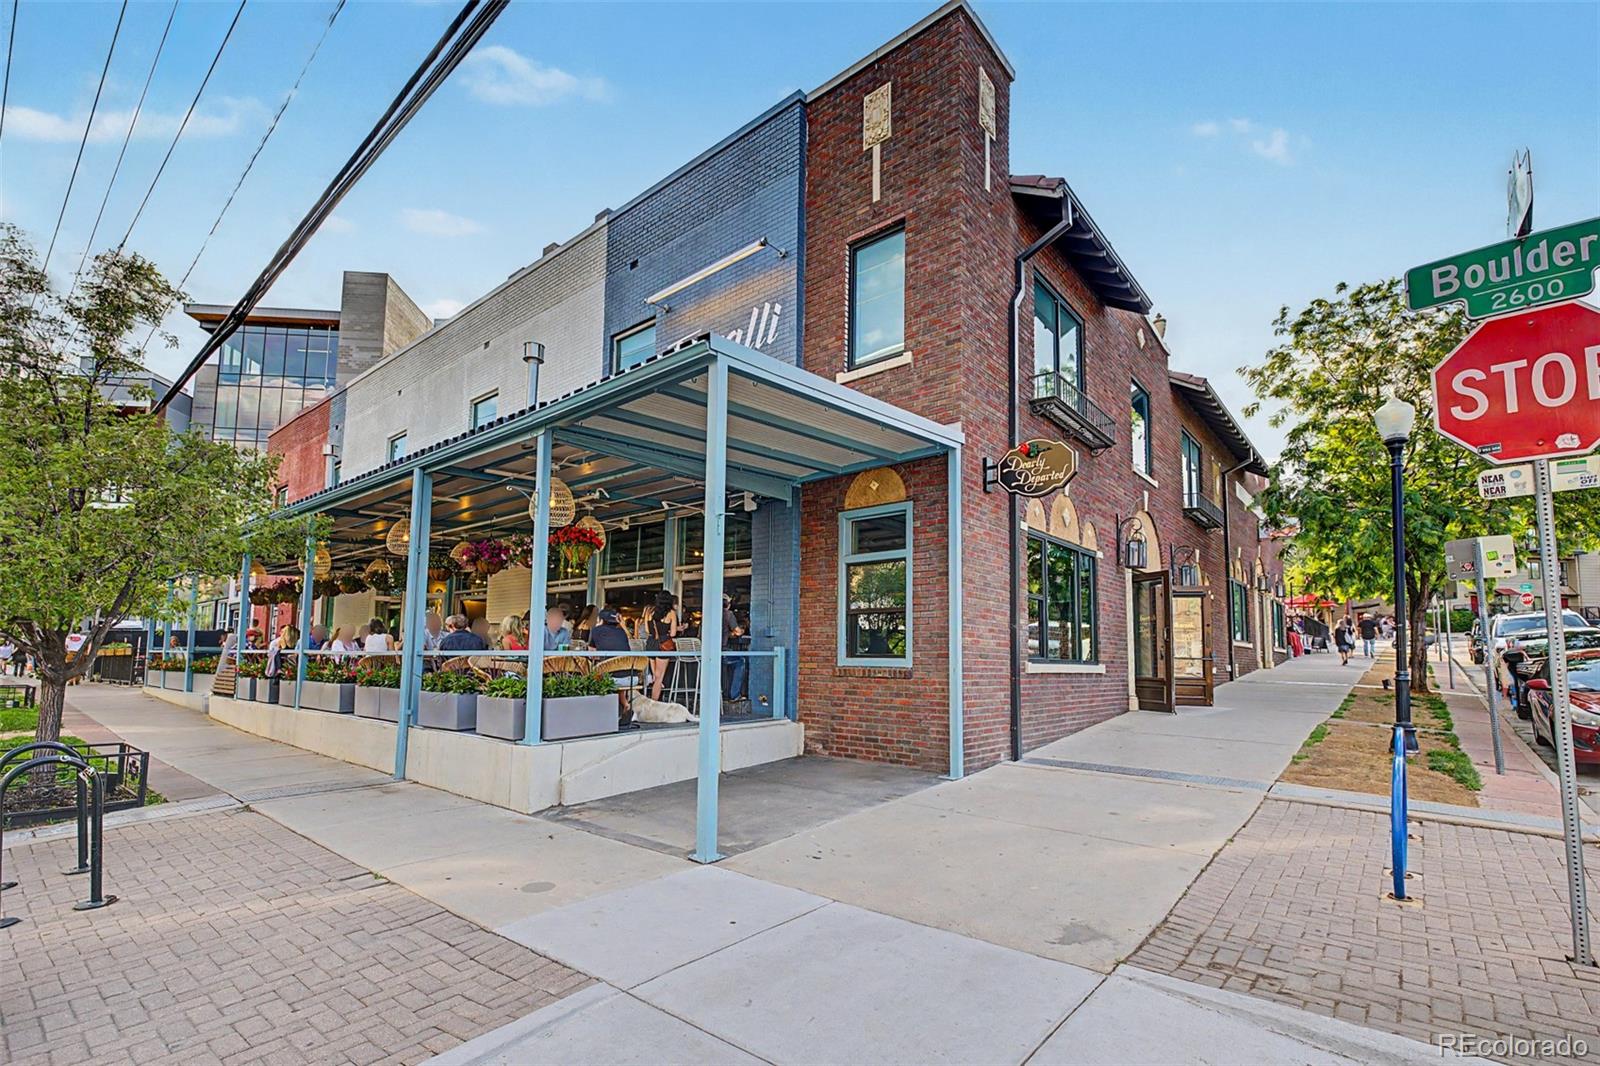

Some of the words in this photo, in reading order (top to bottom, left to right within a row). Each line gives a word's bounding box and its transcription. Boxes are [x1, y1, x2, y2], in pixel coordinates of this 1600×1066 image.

[1431, 234, 1598, 299] Boulder
[1491, 279, 1565, 311] 2600
[1003, 452, 1050, 475] Dearly
[1011, 463, 1069, 492] Departed
[1481, 474, 1504, 484] NEAR
[1483, 486, 1506, 495] NEAR
